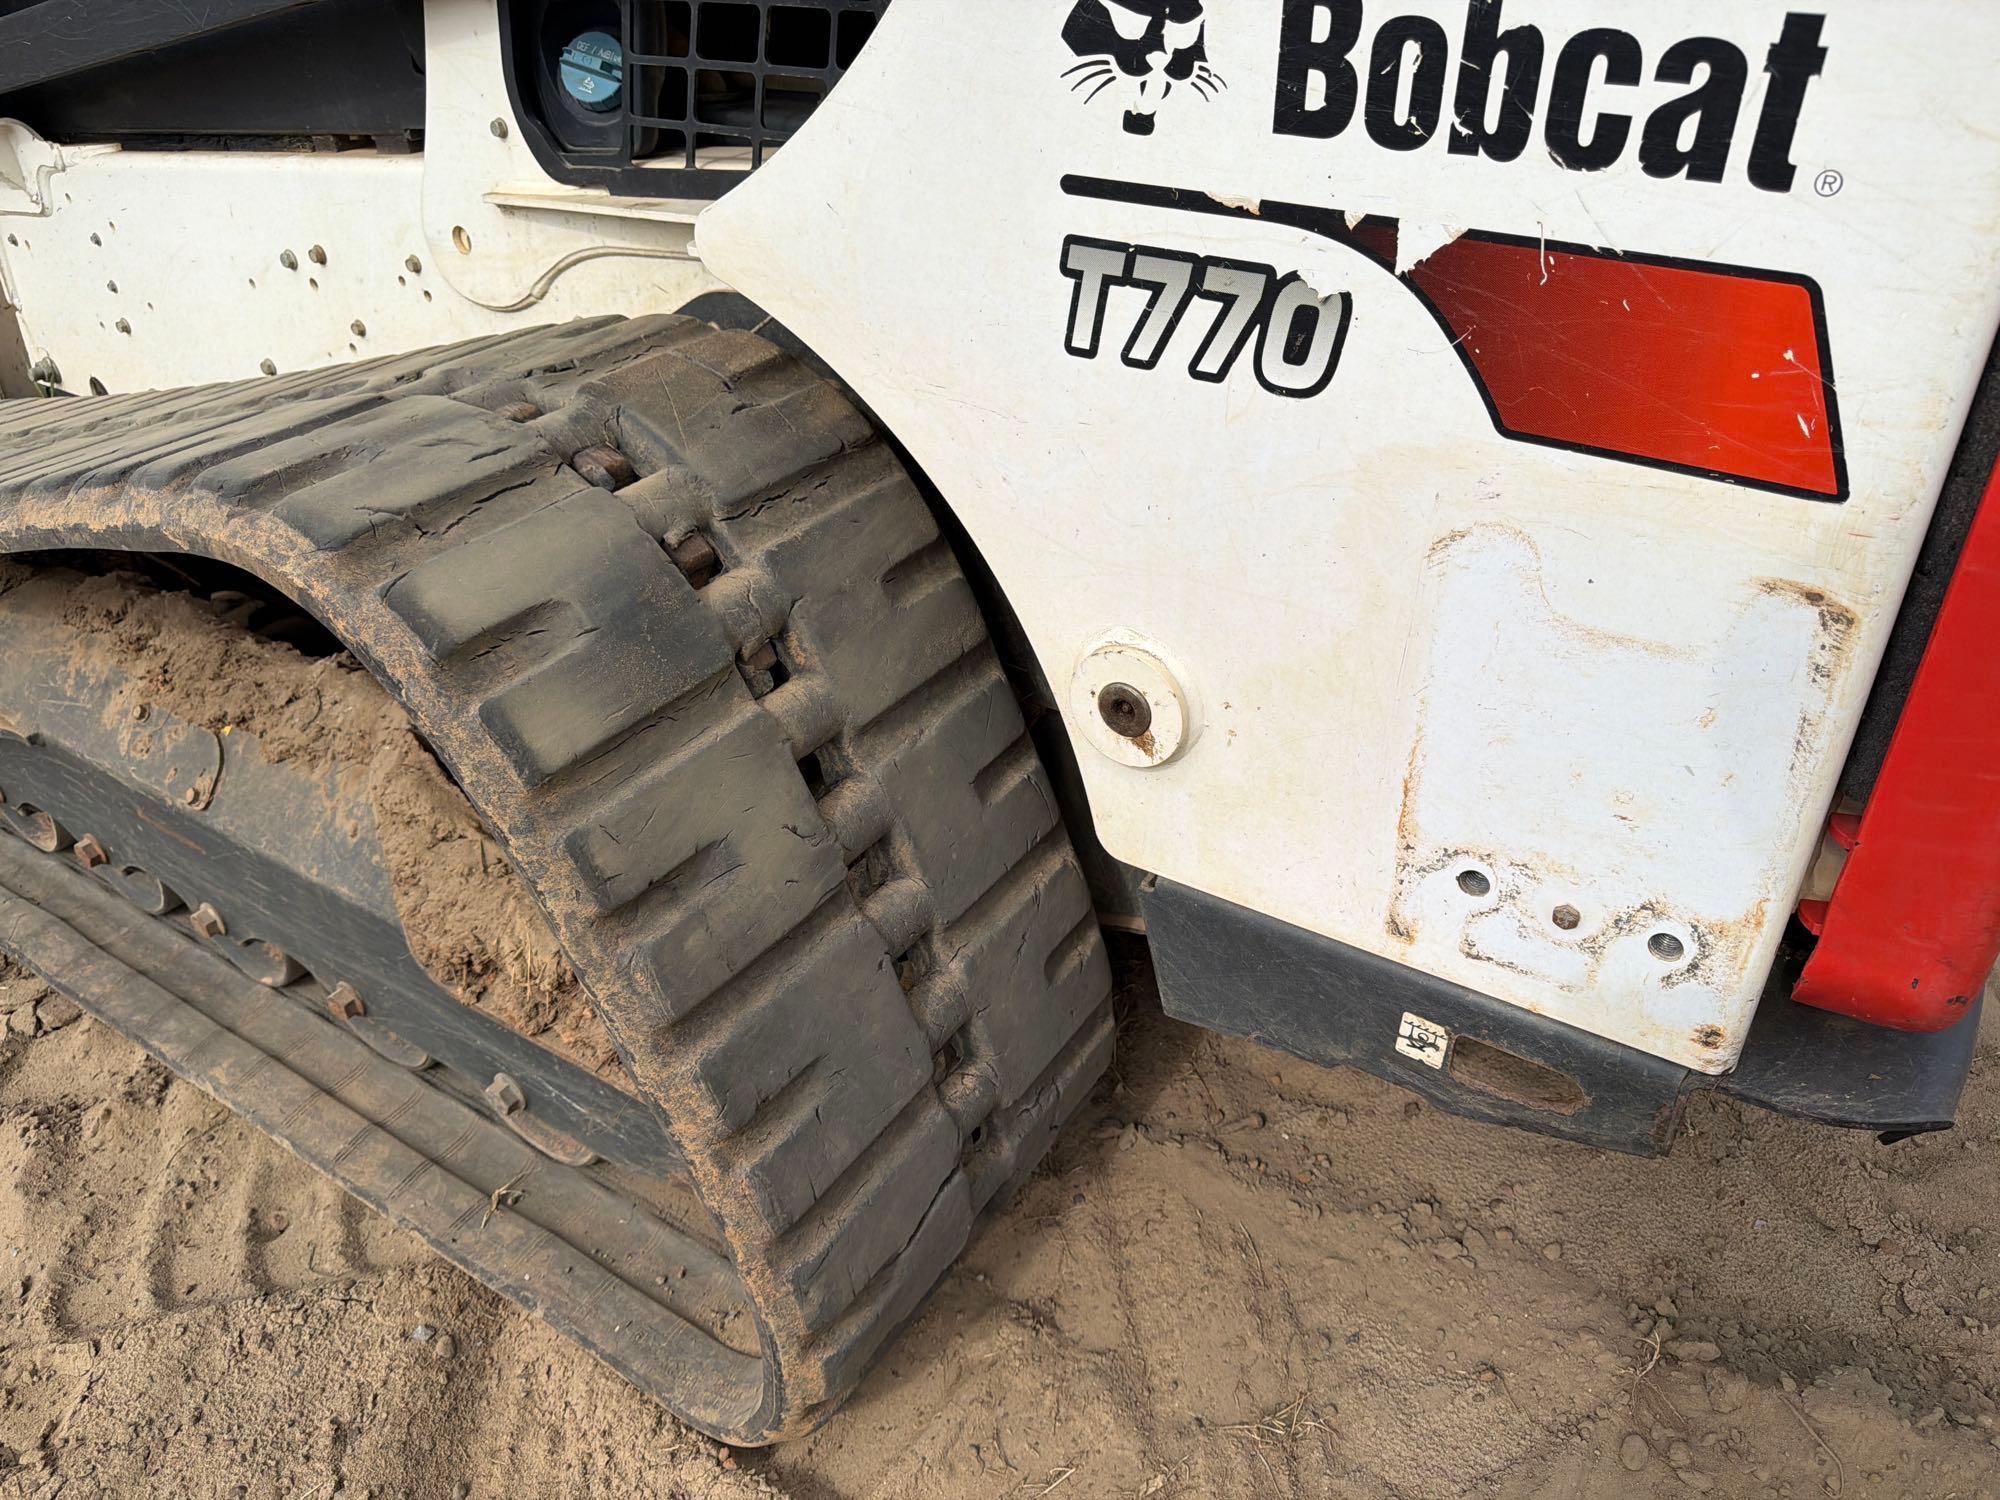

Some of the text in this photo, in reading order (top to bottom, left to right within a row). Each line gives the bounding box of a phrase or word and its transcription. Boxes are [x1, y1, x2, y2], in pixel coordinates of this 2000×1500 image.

[577, 40, 591, 52] DEF
[1272, 0, 1828, 193] Bobcat
[1060, 234, 1353, 399] T770
